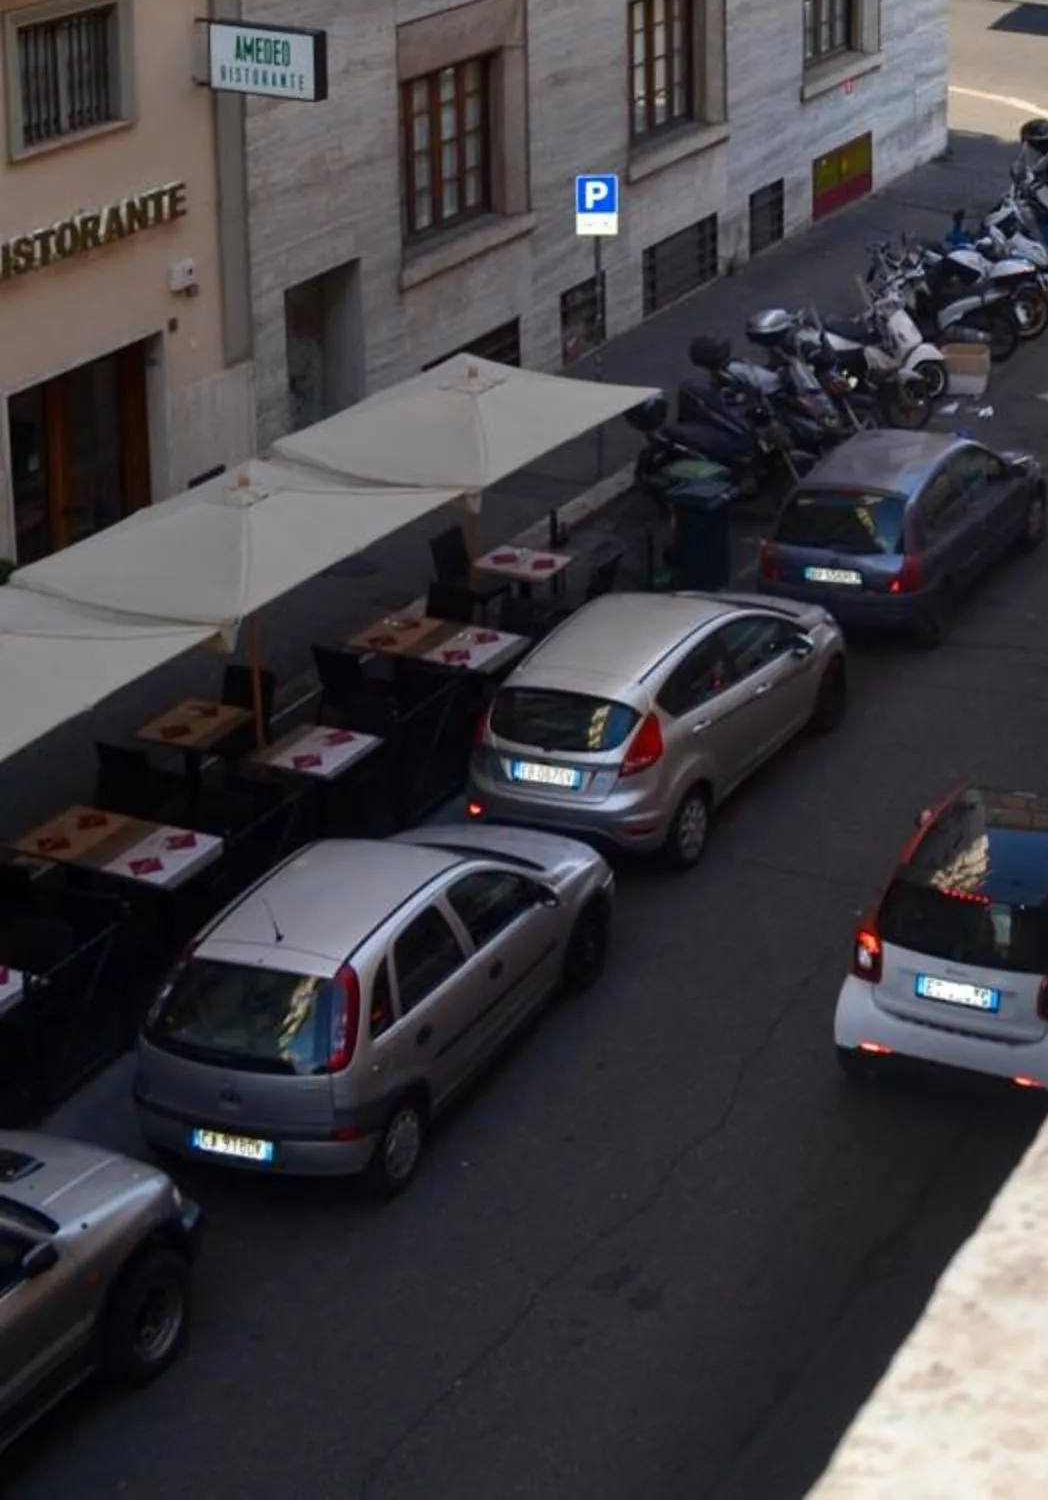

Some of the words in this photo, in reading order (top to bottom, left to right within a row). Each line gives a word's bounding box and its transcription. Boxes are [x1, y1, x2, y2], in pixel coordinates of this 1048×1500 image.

[235, 35, 291, 67] AMEDEO
[220, 64, 304, 92] RISTORANTE
[585, 181, 609, 210] P
